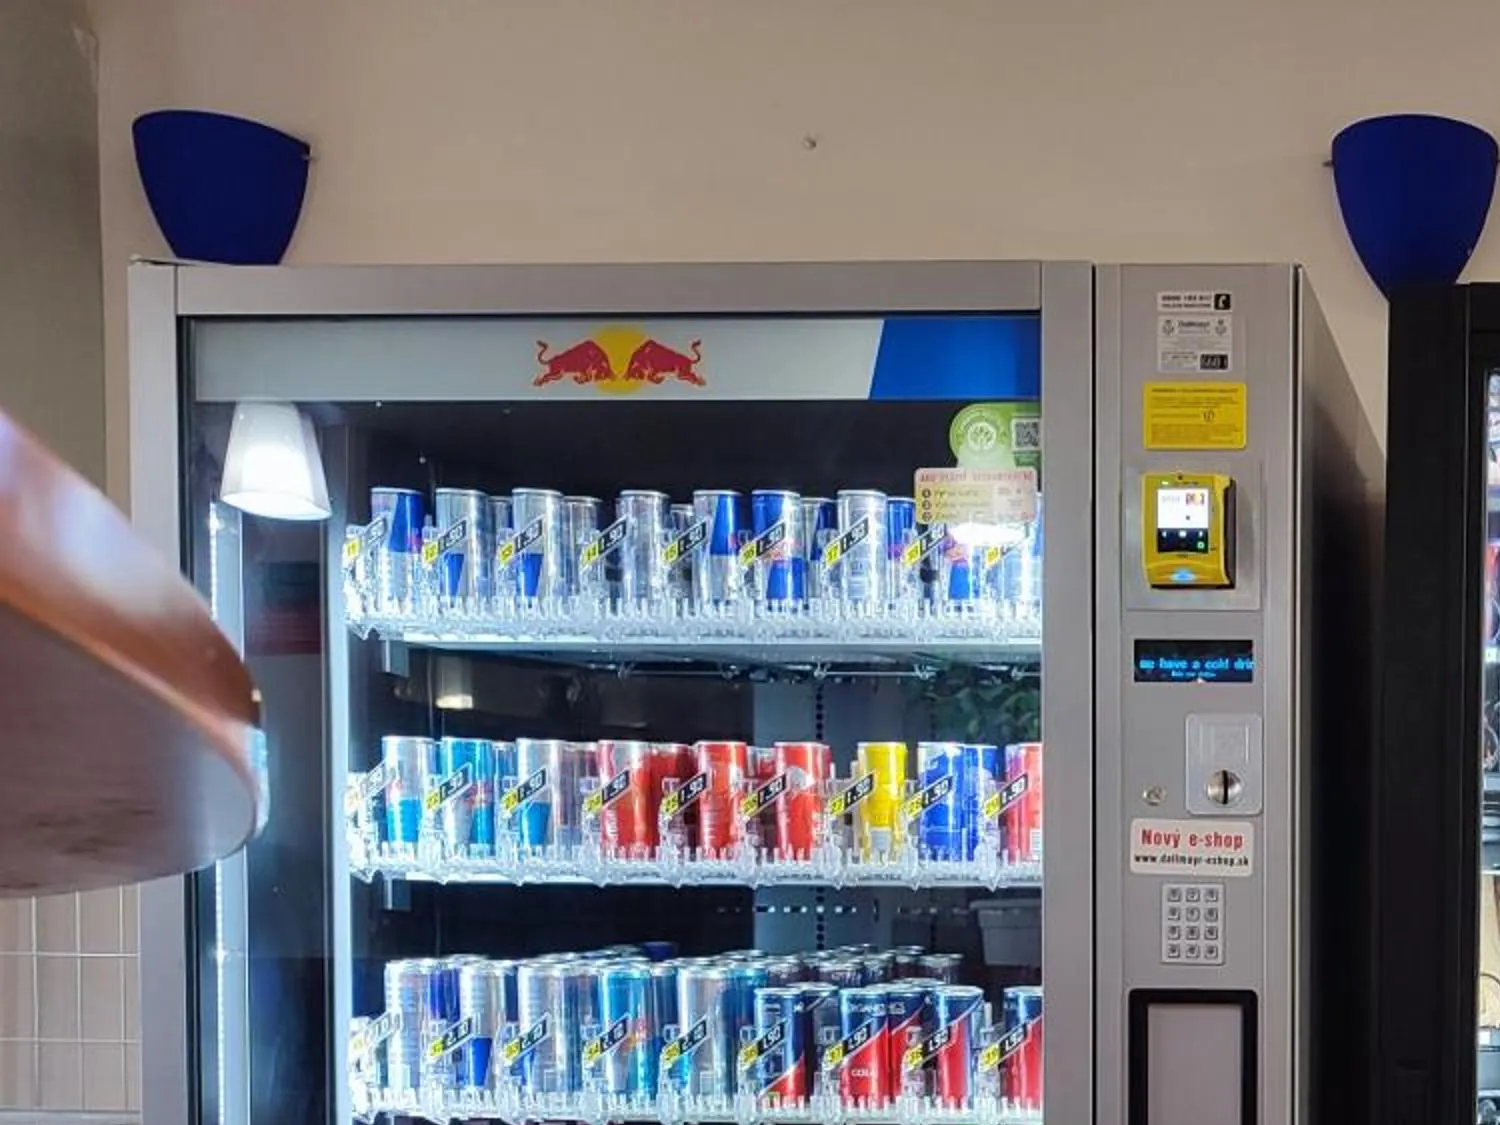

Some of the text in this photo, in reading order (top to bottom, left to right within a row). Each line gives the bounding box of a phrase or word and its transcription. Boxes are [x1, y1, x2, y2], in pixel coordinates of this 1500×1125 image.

[1141, 828, 1244, 850] Nový e-shop
[1134, 853, 1249, 867] www.dallmayr-eshop.sk
